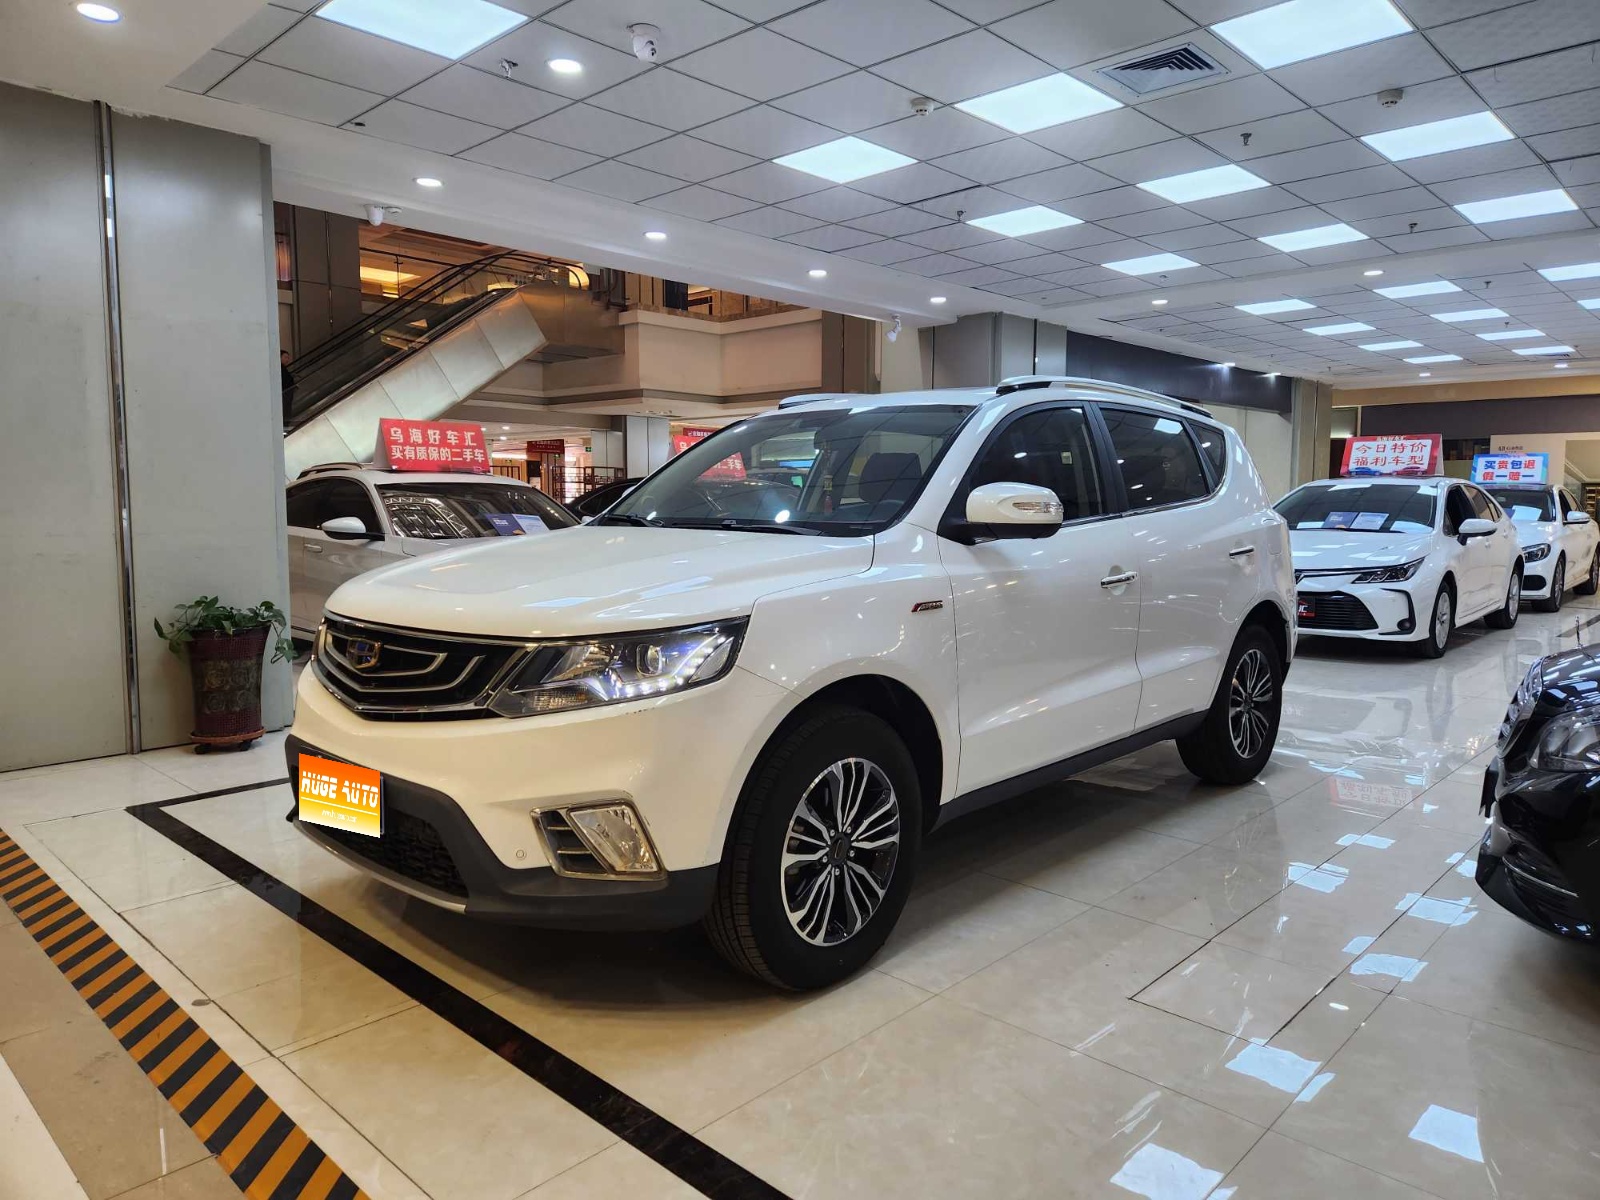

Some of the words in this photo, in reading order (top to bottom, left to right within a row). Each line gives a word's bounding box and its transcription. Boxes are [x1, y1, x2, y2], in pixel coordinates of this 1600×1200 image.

[390, 427, 477, 446] 乌海好车汇
[391, 445, 485, 463] 买有质保的二手车
[1355, 442, 1427, 454] 今日特价
[1352, 455, 1424, 467] 福利车型
[1484, 459, 1536, 470] 买贵包退
[1482, 471, 1534, 481] 假一赔一
